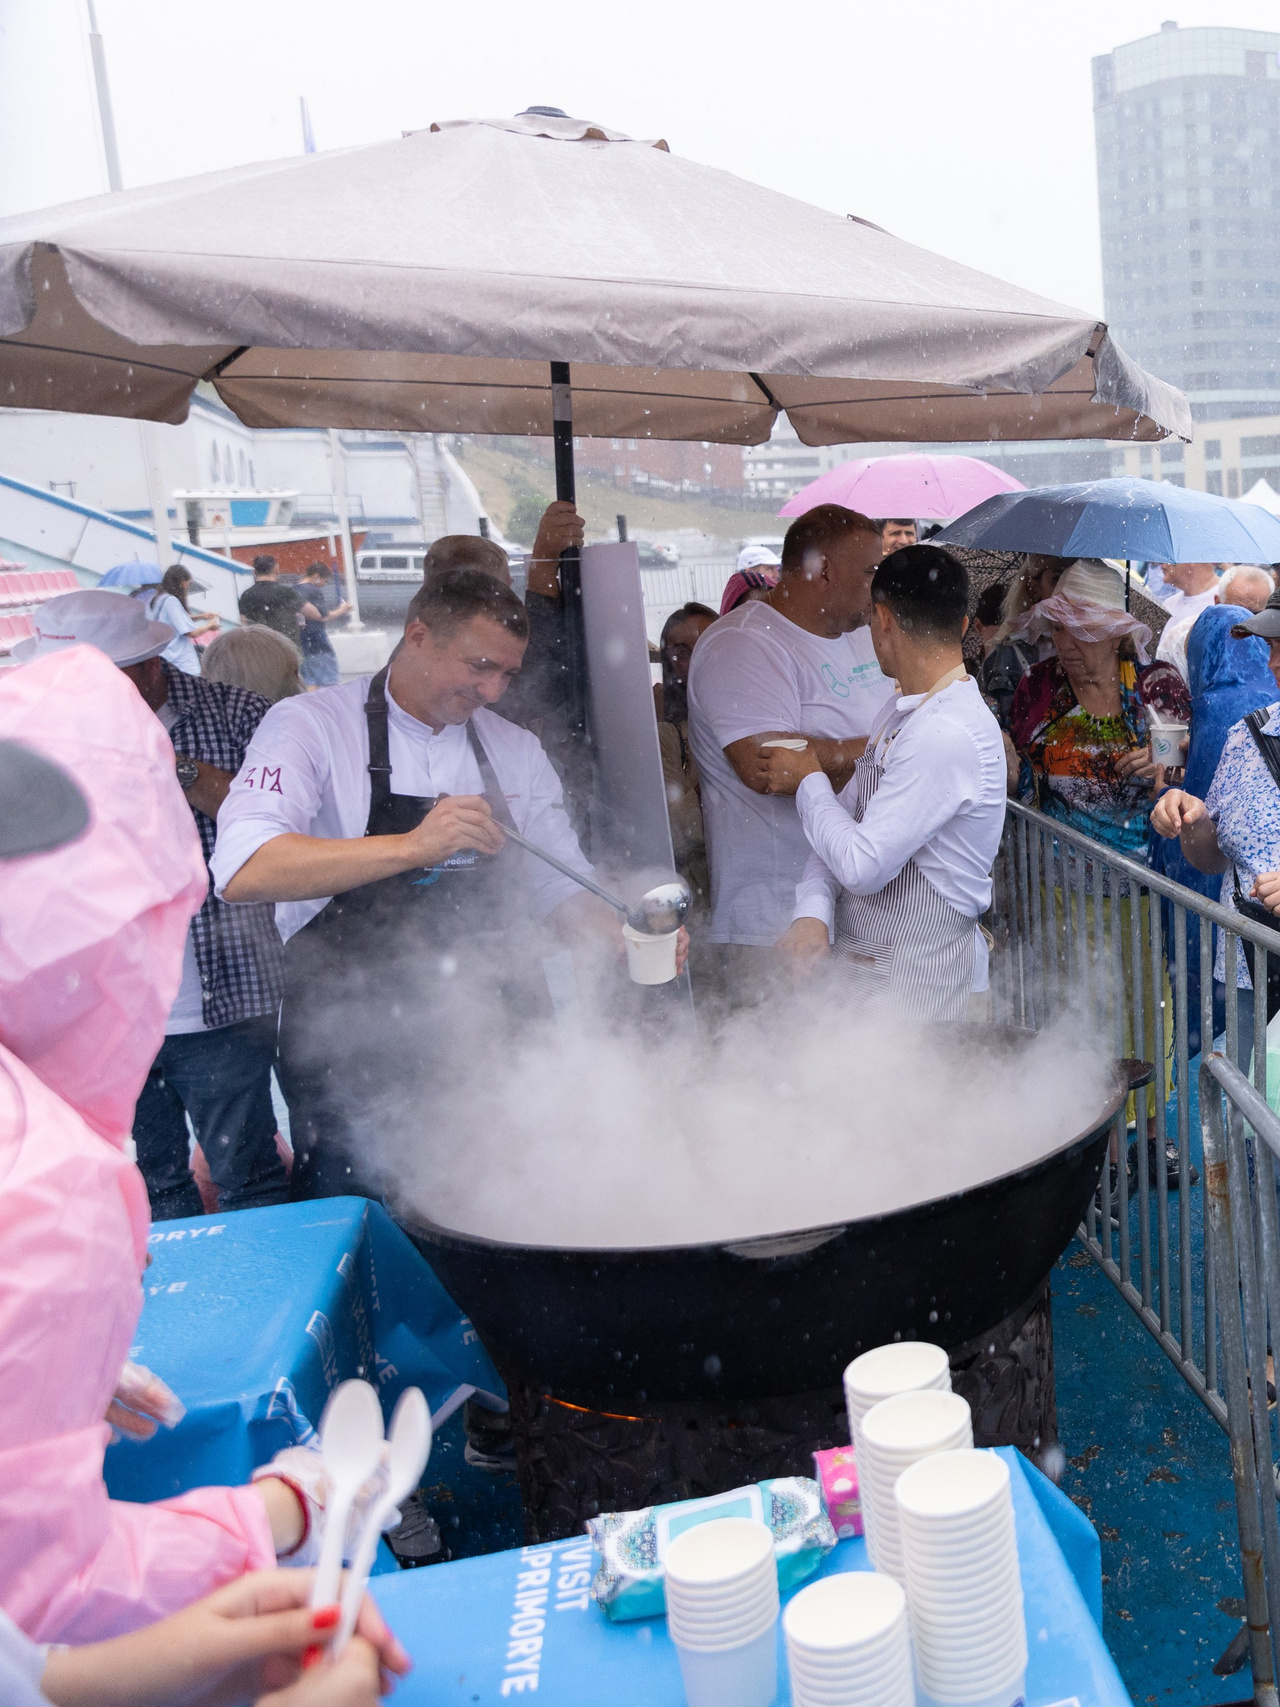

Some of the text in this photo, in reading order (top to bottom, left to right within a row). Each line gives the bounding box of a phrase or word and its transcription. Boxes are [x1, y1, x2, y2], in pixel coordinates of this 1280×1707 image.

[148, 1225, 227, 1244] ORYE
[555, 1544, 593, 1612] VISIT
[501, 1551, 552, 1697] PRIMORYE
